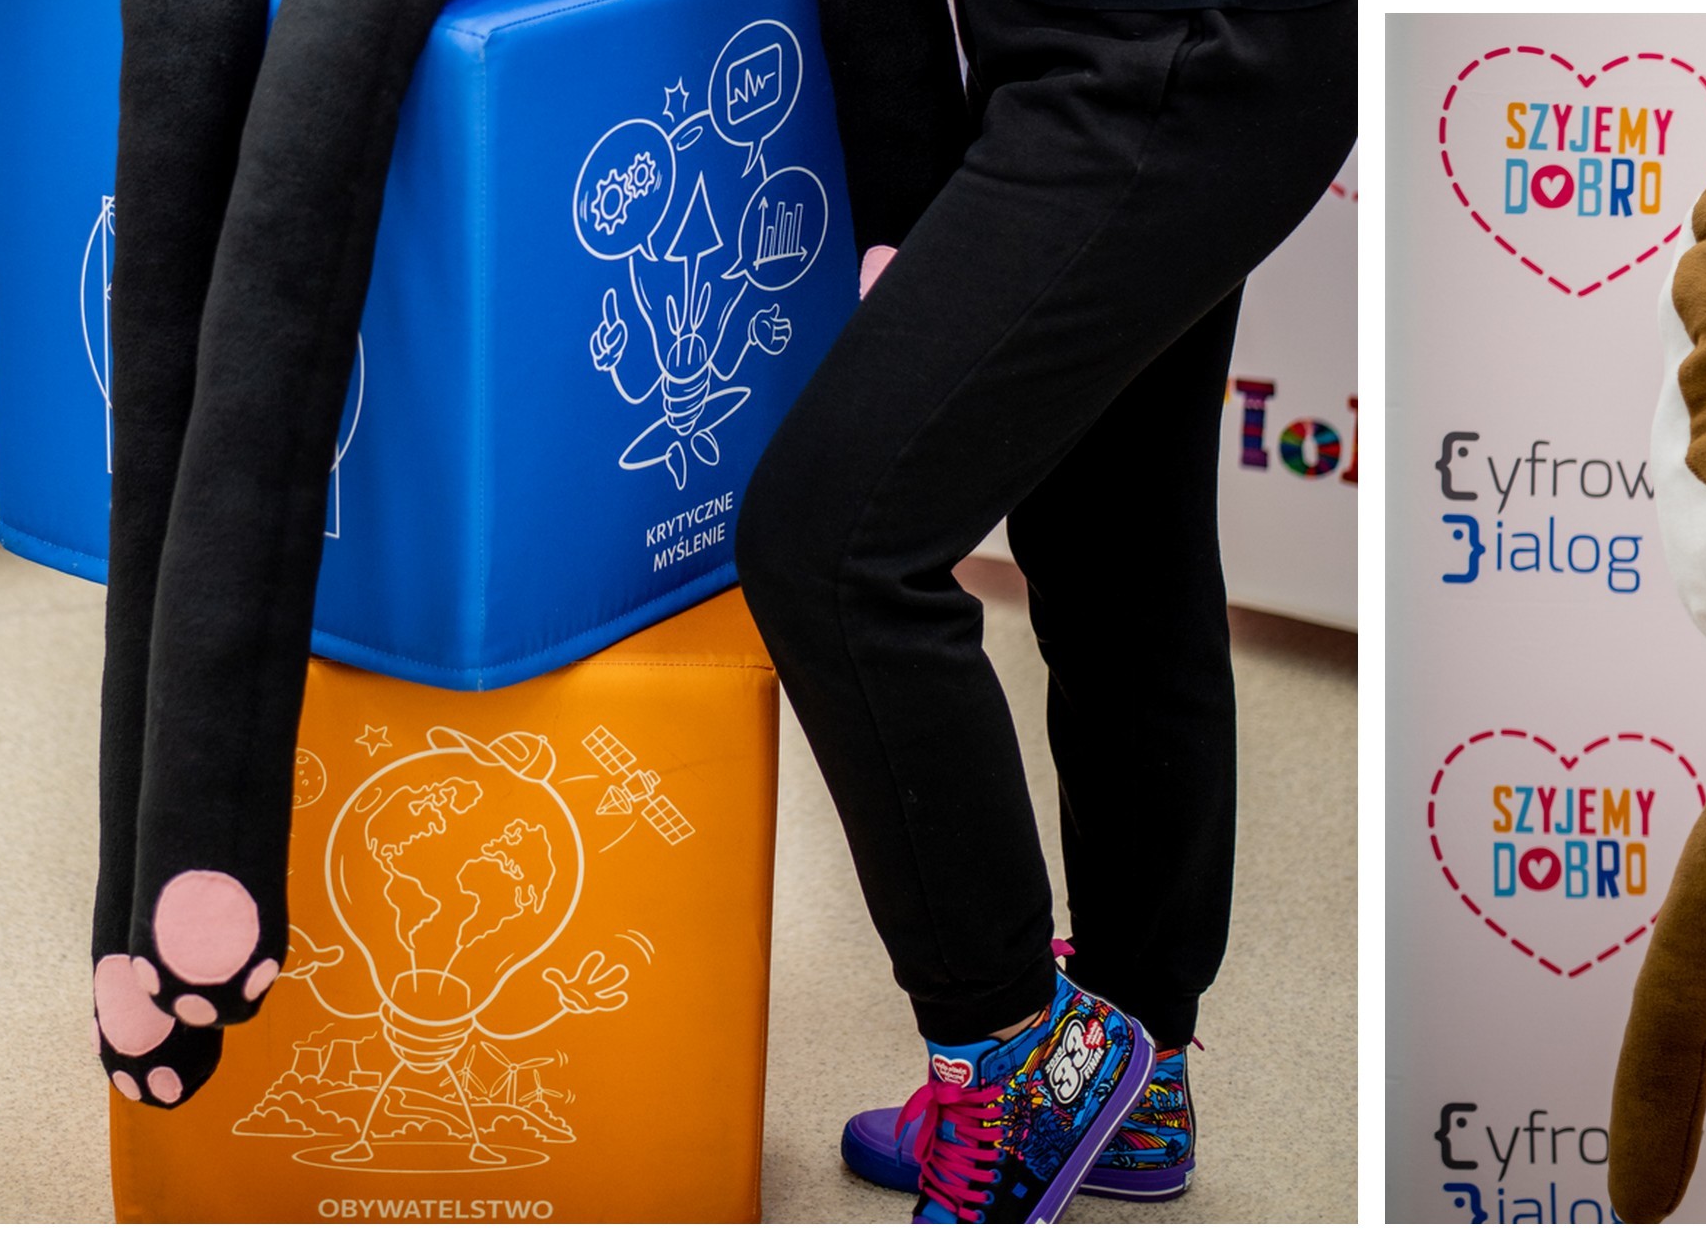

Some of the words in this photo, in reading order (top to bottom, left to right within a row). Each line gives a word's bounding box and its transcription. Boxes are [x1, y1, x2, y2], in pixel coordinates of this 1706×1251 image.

[1505, 101, 1674, 156] SZYJEMY
[1504, 158, 1662, 218] DOBRO
[1434, 431, 1656, 512] Cyfrow
[646, 491, 734, 548] KRYTYCZNE
[653, 522, 726, 573] MYŚLENIE
[1441, 513, 1643, 594] Dialog
[1492, 784, 1655, 837] SZYJEMY
[1493, 839, 1647, 899] DOBRO
[1053, 1021, 1090, 1099] 33
[1434, 1103, 1609, 1181] Cyfro
[317, 1198, 555, 1220] OBYWATELSTWO
[1442, 1182, 1625, 1224] Dialo
